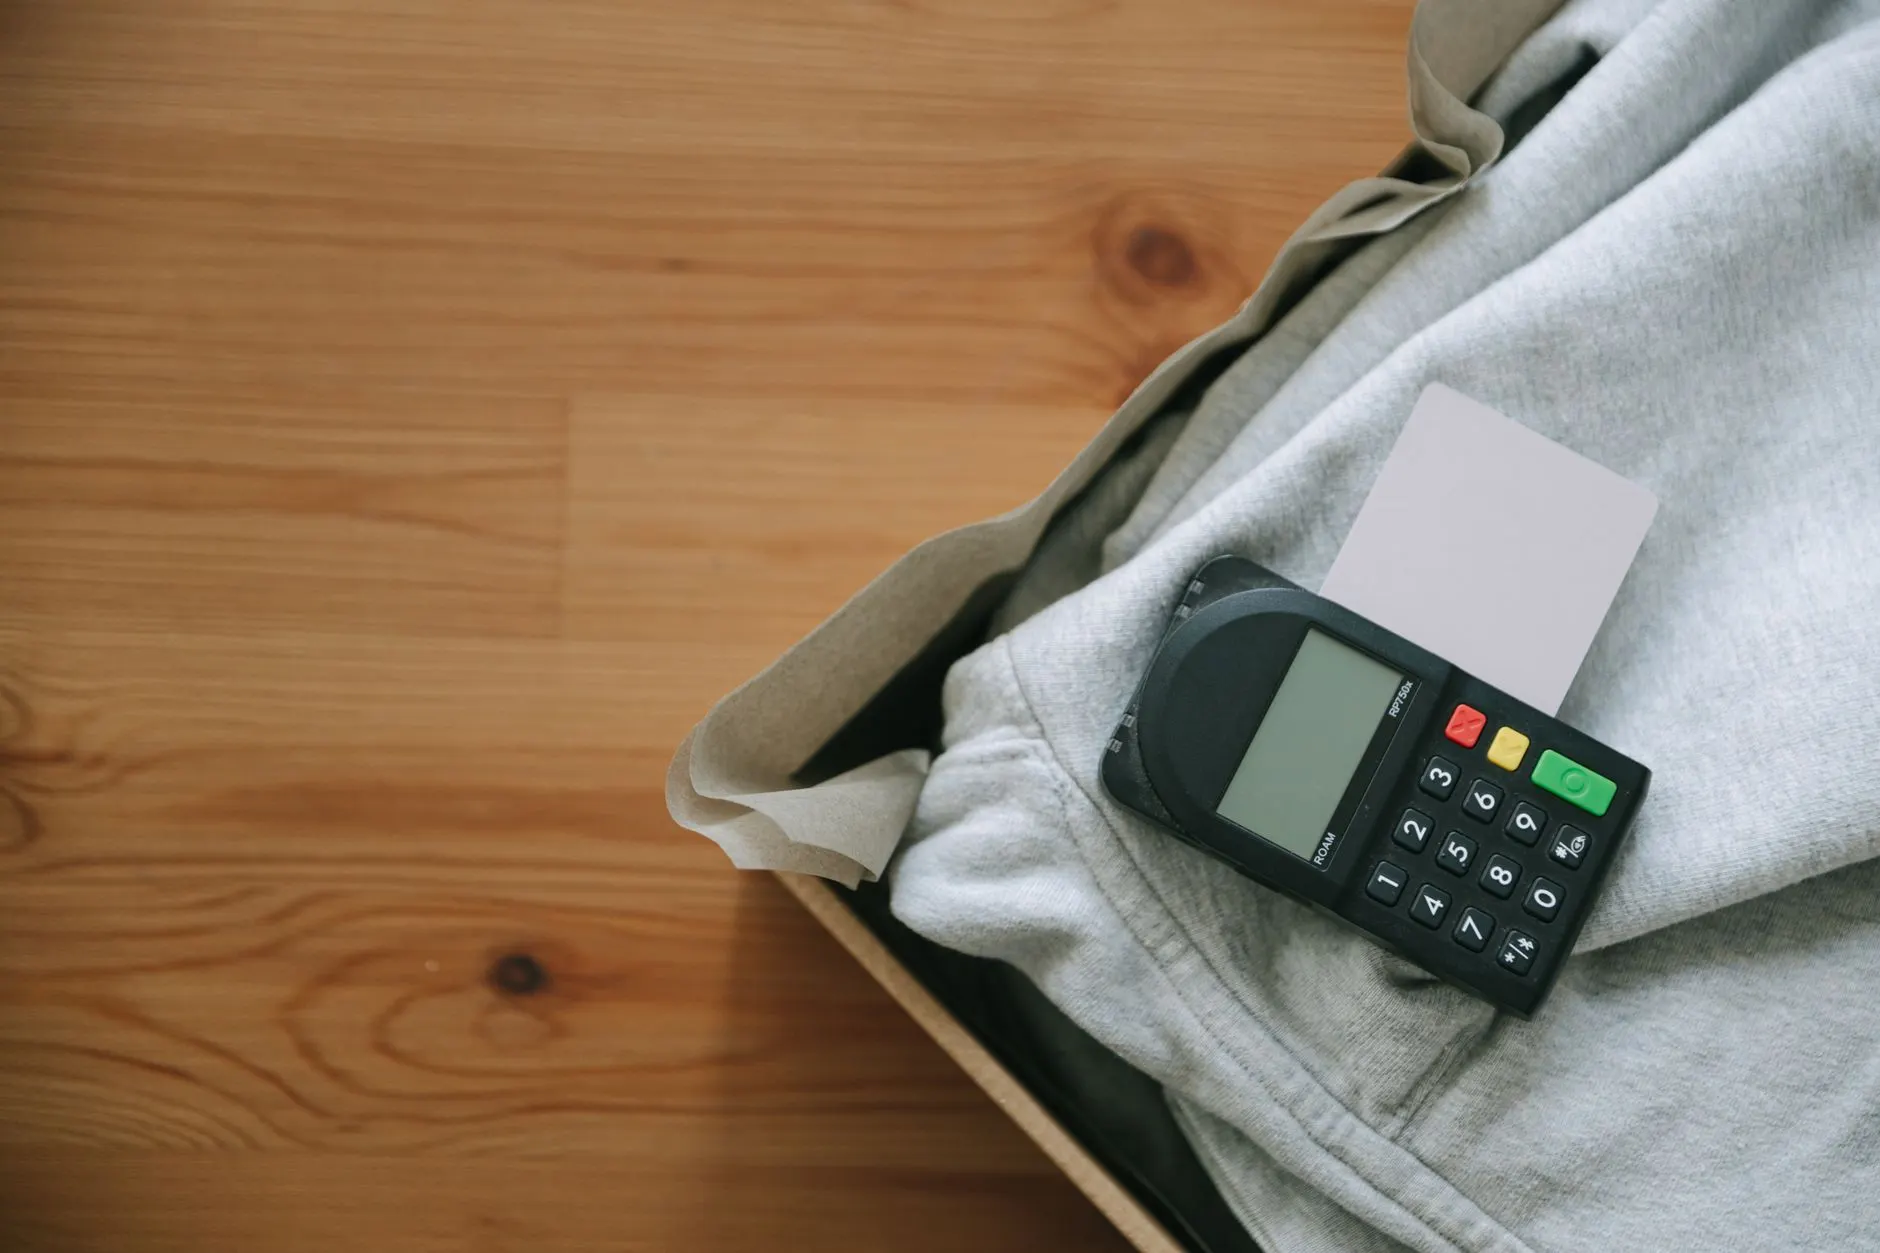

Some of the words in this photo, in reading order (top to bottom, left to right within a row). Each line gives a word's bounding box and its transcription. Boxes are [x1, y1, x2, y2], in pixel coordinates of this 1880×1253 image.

[1388, 680, 1414, 718] RP750x
[1430, 767, 1452, 787] 3
[1474, 792, 1496, 810] 6
[1403, 820, 1427, 841] 2
[1515, 812, 1537, 831] 9
[1313, 832, 1336, 866] ROAM
[1447, 841, 1468, 863] 5
[1377, 874, 1399, 888] 1
[1489, 865, 1513, 886] 8
[1423, 894, 1444, 916] 4
[1533, 888, 1557, 908] 0
[1461, 915, 1483, 940] 7
